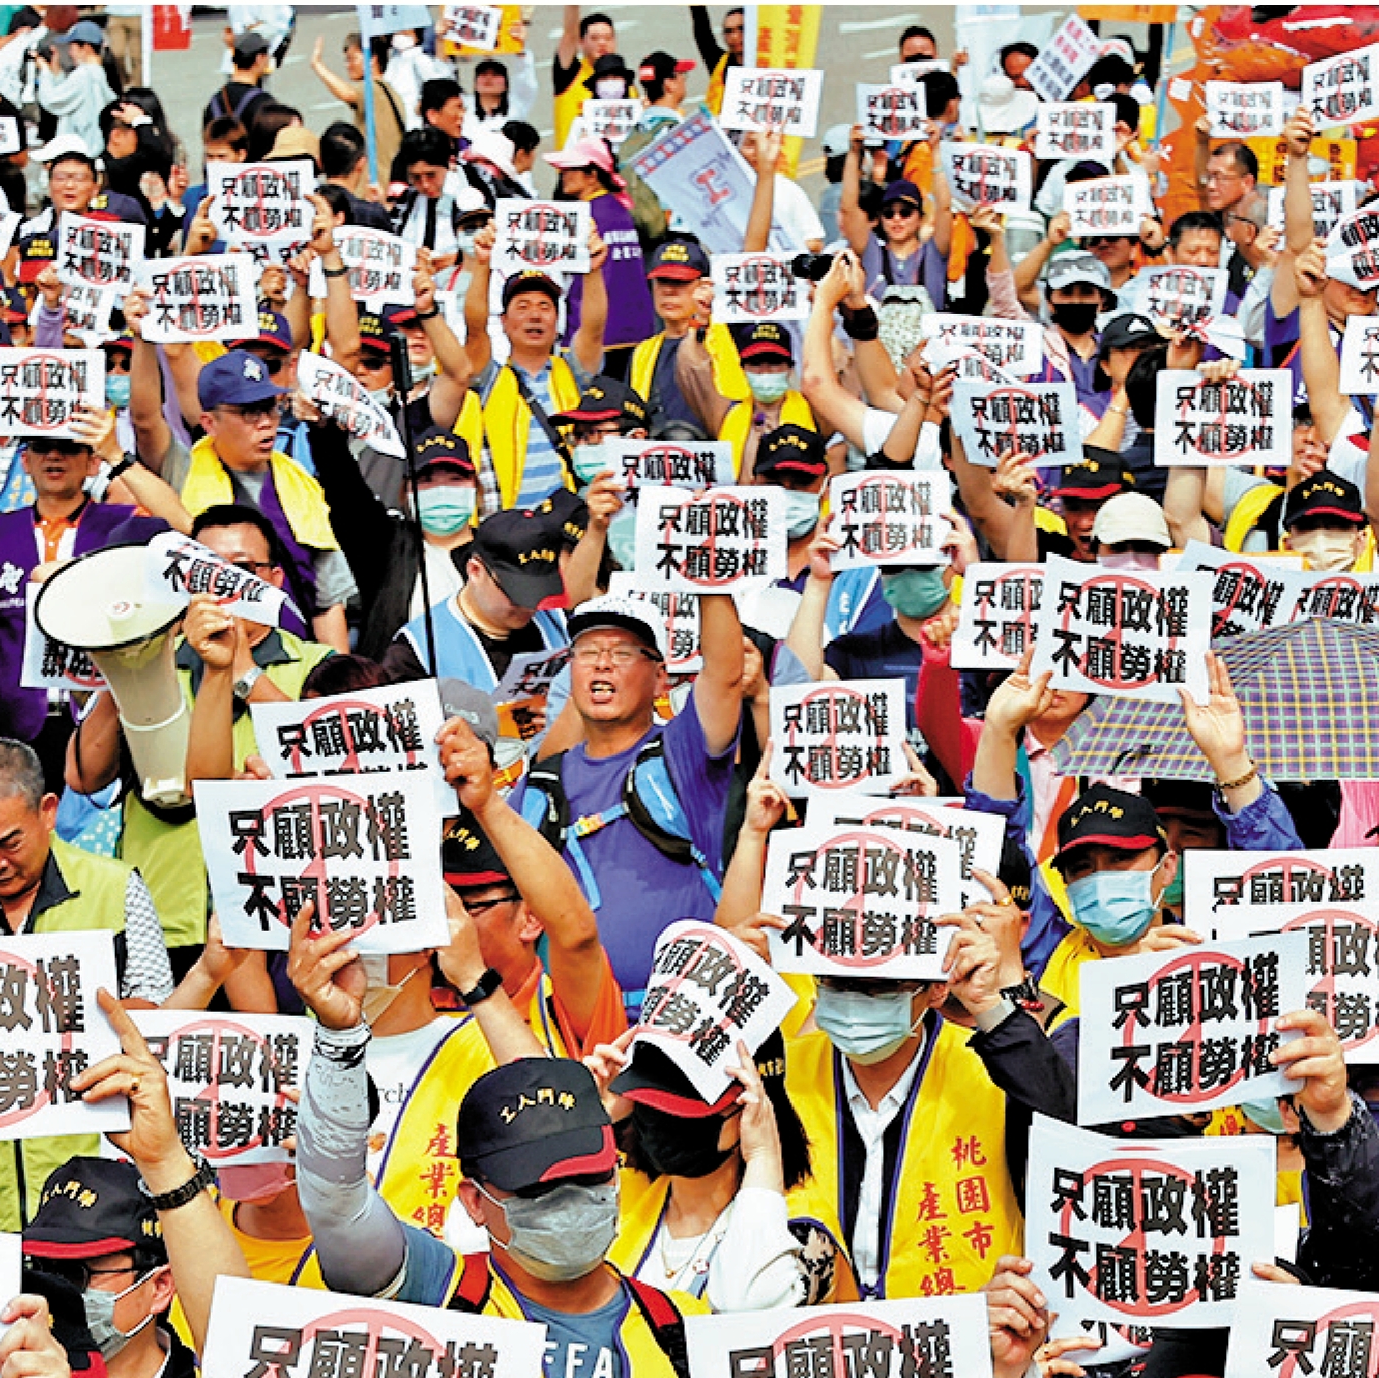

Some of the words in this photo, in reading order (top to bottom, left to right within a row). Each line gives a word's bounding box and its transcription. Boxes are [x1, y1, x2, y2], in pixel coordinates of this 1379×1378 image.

[972, 393, 1061, 426] 只顧政權
[1176, 381, 1273, 417] 只顧政權
[1174, 421, 1273, 453] 不顧勞權
[622, 453, 716, 483] 只顧政權
[657, 499, 768, 540] 只顧政權
[841, 480, 932, 516] 只顧政權
[657, 543, 768, 579] 不顧勞權
[841, 522, 932, 559] 不顧勞權
[1058, 581, 1189, 637] 只顧政權
[1052, 628, 1186, 684] 不顧勞權
[277, 698, 424, 761] 只顧政權
[784, 693, 889, 737] 只顧政權
[784, 744, 891, 786] 不顧勞權
[228, 791, 411, 863] 只顧政權
[237, 873, 417, 932] 不顧勞權
[785, 848, 938, 905] 只顧政權
[783, 905, 938, 957] 不顧勞權
[1114, 951, 1280, 1029] 只顧政權
[1109, 1033, 1279, 1103] 不顧勞權
[951, 1134, 995, 1261] 桃園市
[1050, 1165, 1240, 1238] 只顧政權
[1048, 1233, 1241, 1303] 不顧勞權
